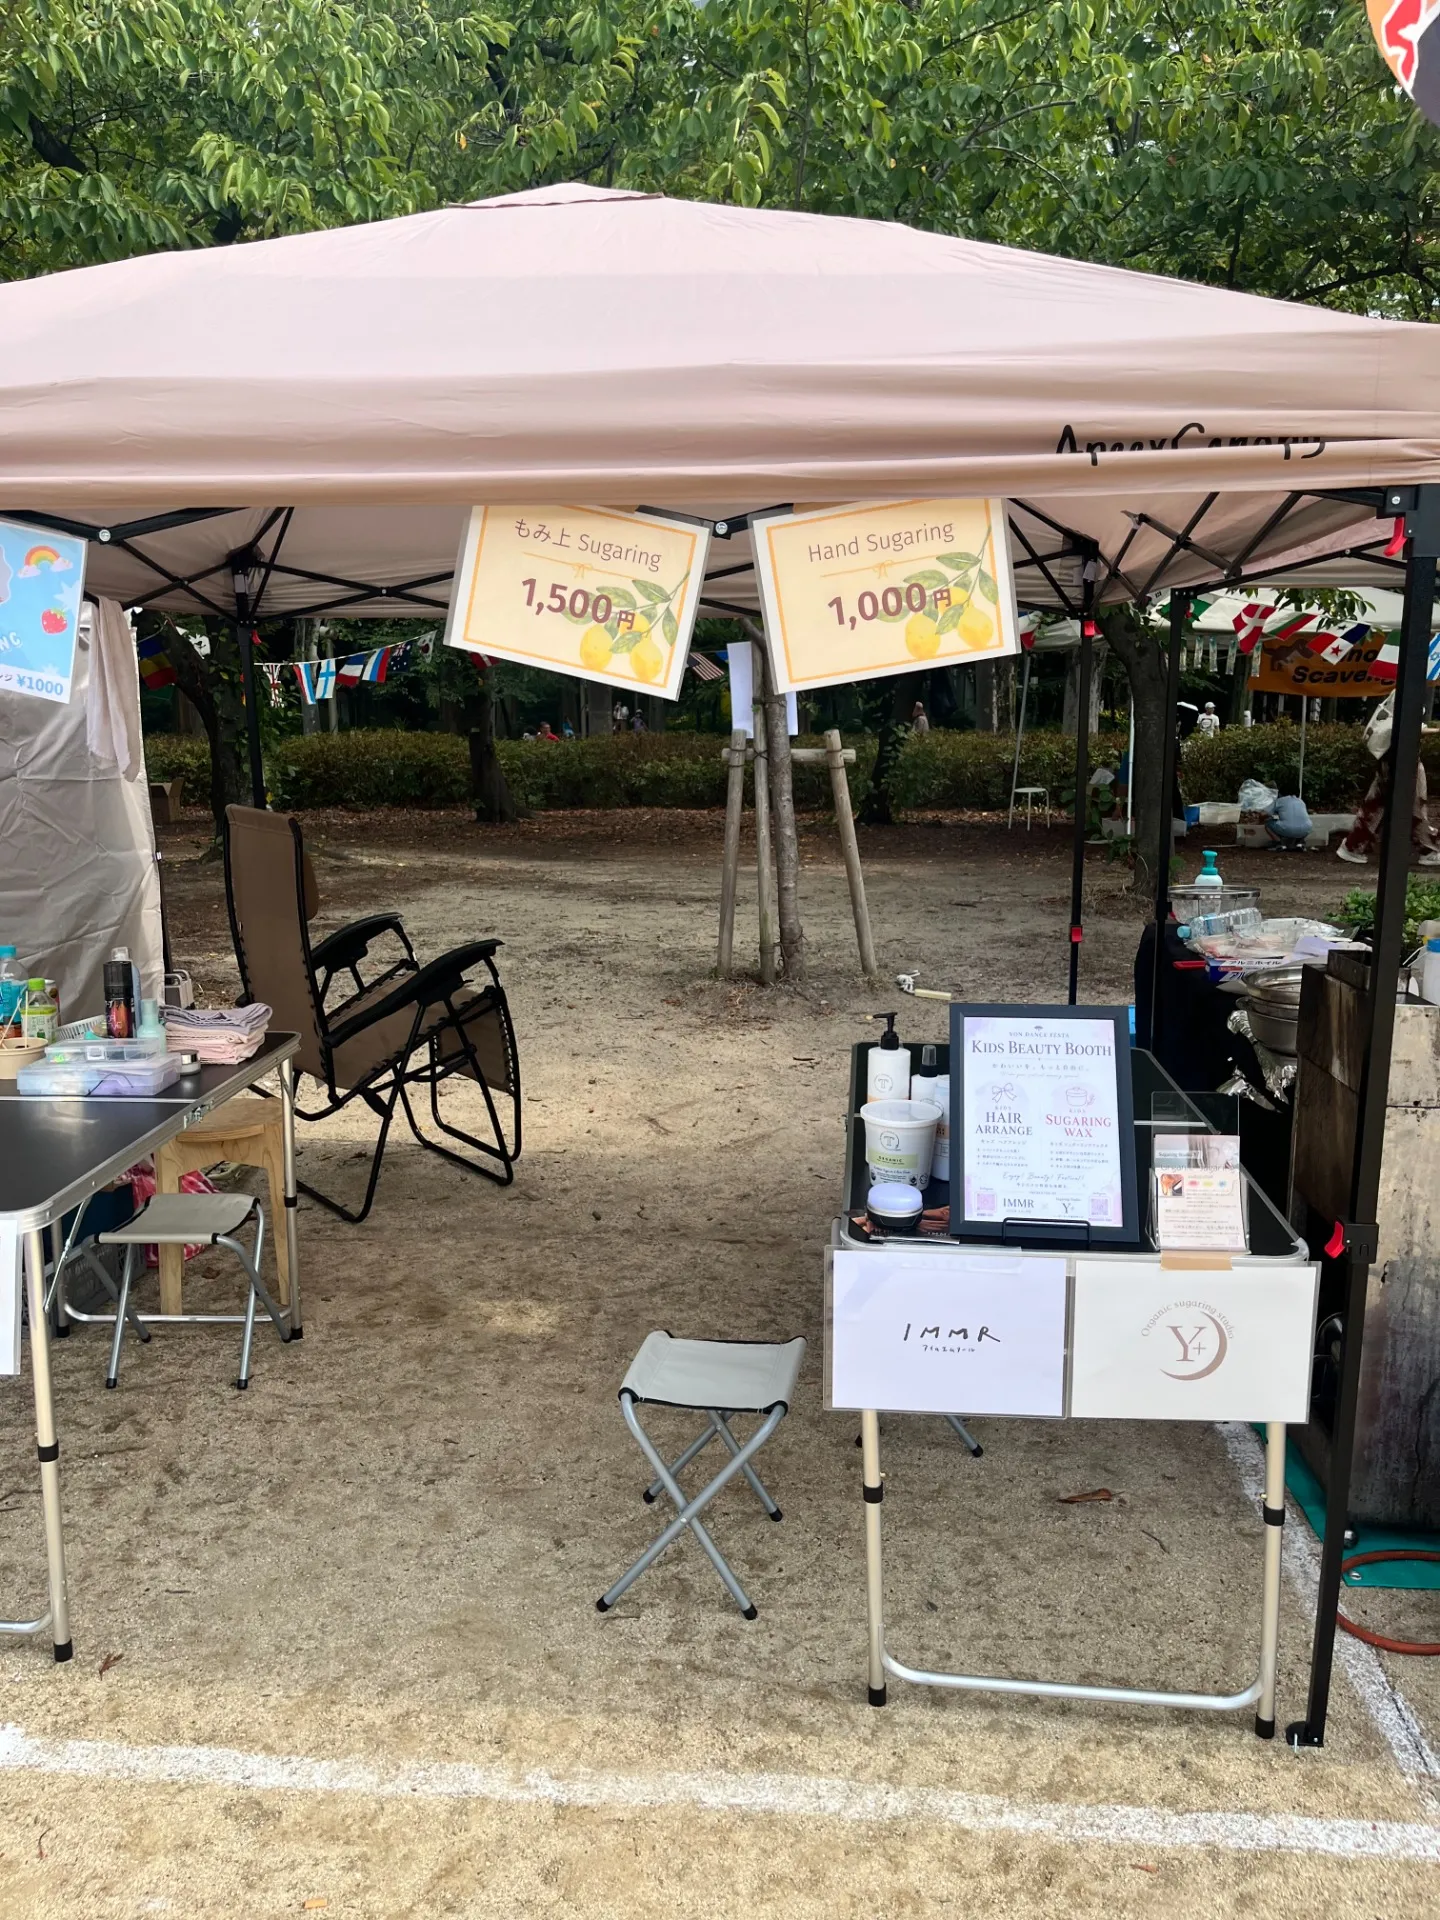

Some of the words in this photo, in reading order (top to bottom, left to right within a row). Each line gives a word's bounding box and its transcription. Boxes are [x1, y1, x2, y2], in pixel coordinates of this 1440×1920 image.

[515, 519, 571, 548] もみ上
[578, 534, 661, 572] Sugaring
[808, 536, 859, 562] Hand
[866, 523, 955, 552] Sugaring
[16, 674, 64, 696] ¥1000
[972, 1040, 1005, 1054] KIDS
[1008, 1040, 1062, 1055] BEAUTY
[1065, 1042, 1112, 1056] BOOTH
[986, 1111, 1022, 1124] HAIR
[1045, 1113, 1112, 1128] SUGARING
[975, 1124, 1033, 1136] ARRANGE
[1064, 1127, 1093, 1138] WAX
[1003, 1197, 1034, 1208] IMMR
[1140, 1304, 1172, 1337] Organic
[1174, 1300, 1217, 1315] sugaring
[1217, 1312, 1235, 1339] studio
[903, 1323, 1001, 1342] IMMR
